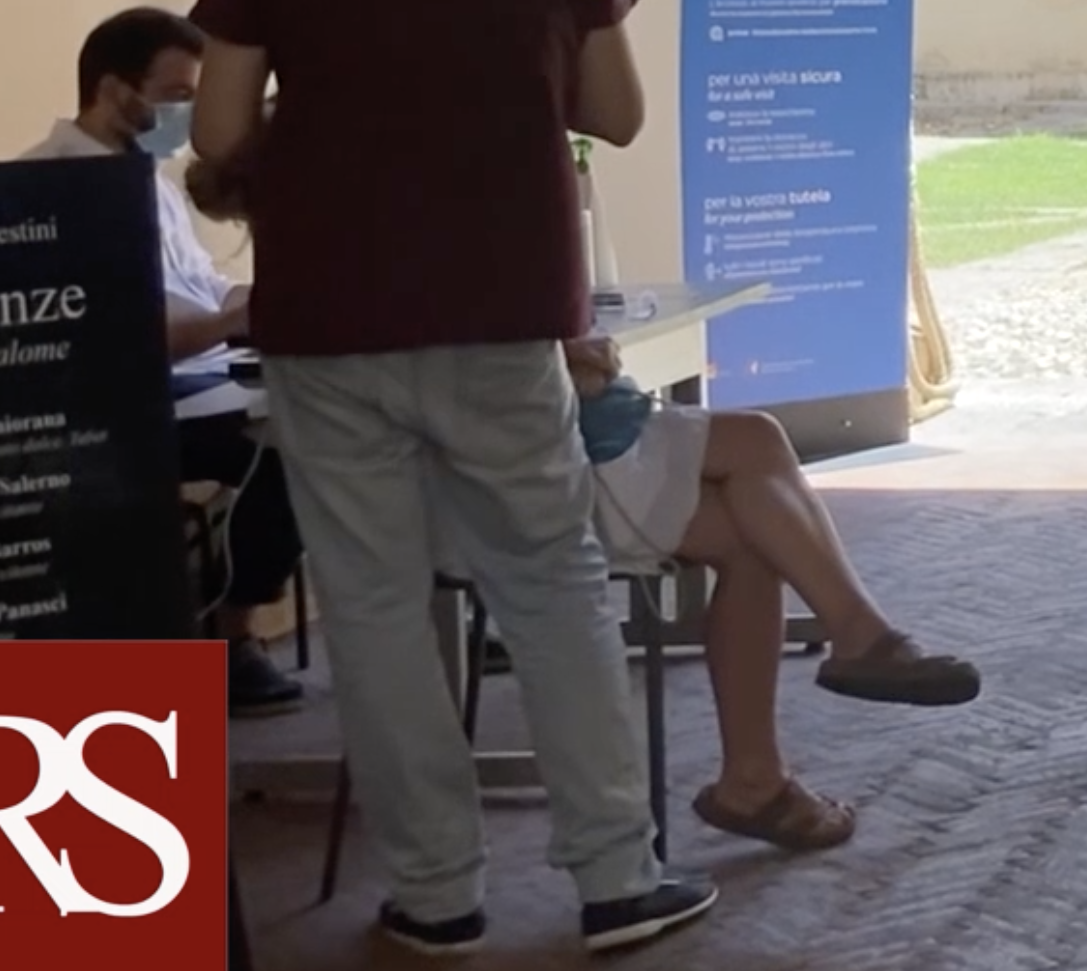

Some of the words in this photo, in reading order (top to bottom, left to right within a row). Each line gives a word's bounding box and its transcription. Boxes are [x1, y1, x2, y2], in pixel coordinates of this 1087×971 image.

[708, 74, 731, 89] per
[733, 73, 760, 86] una
[763, 70, 798, 85] visita
[800, 69, 842, 84] sicura
[704, 196, 726, 211] per
[745, 192, 787, 207] vostra
[789, 188, 831, 205] tutela
[0, 284, 87, 326] nze
